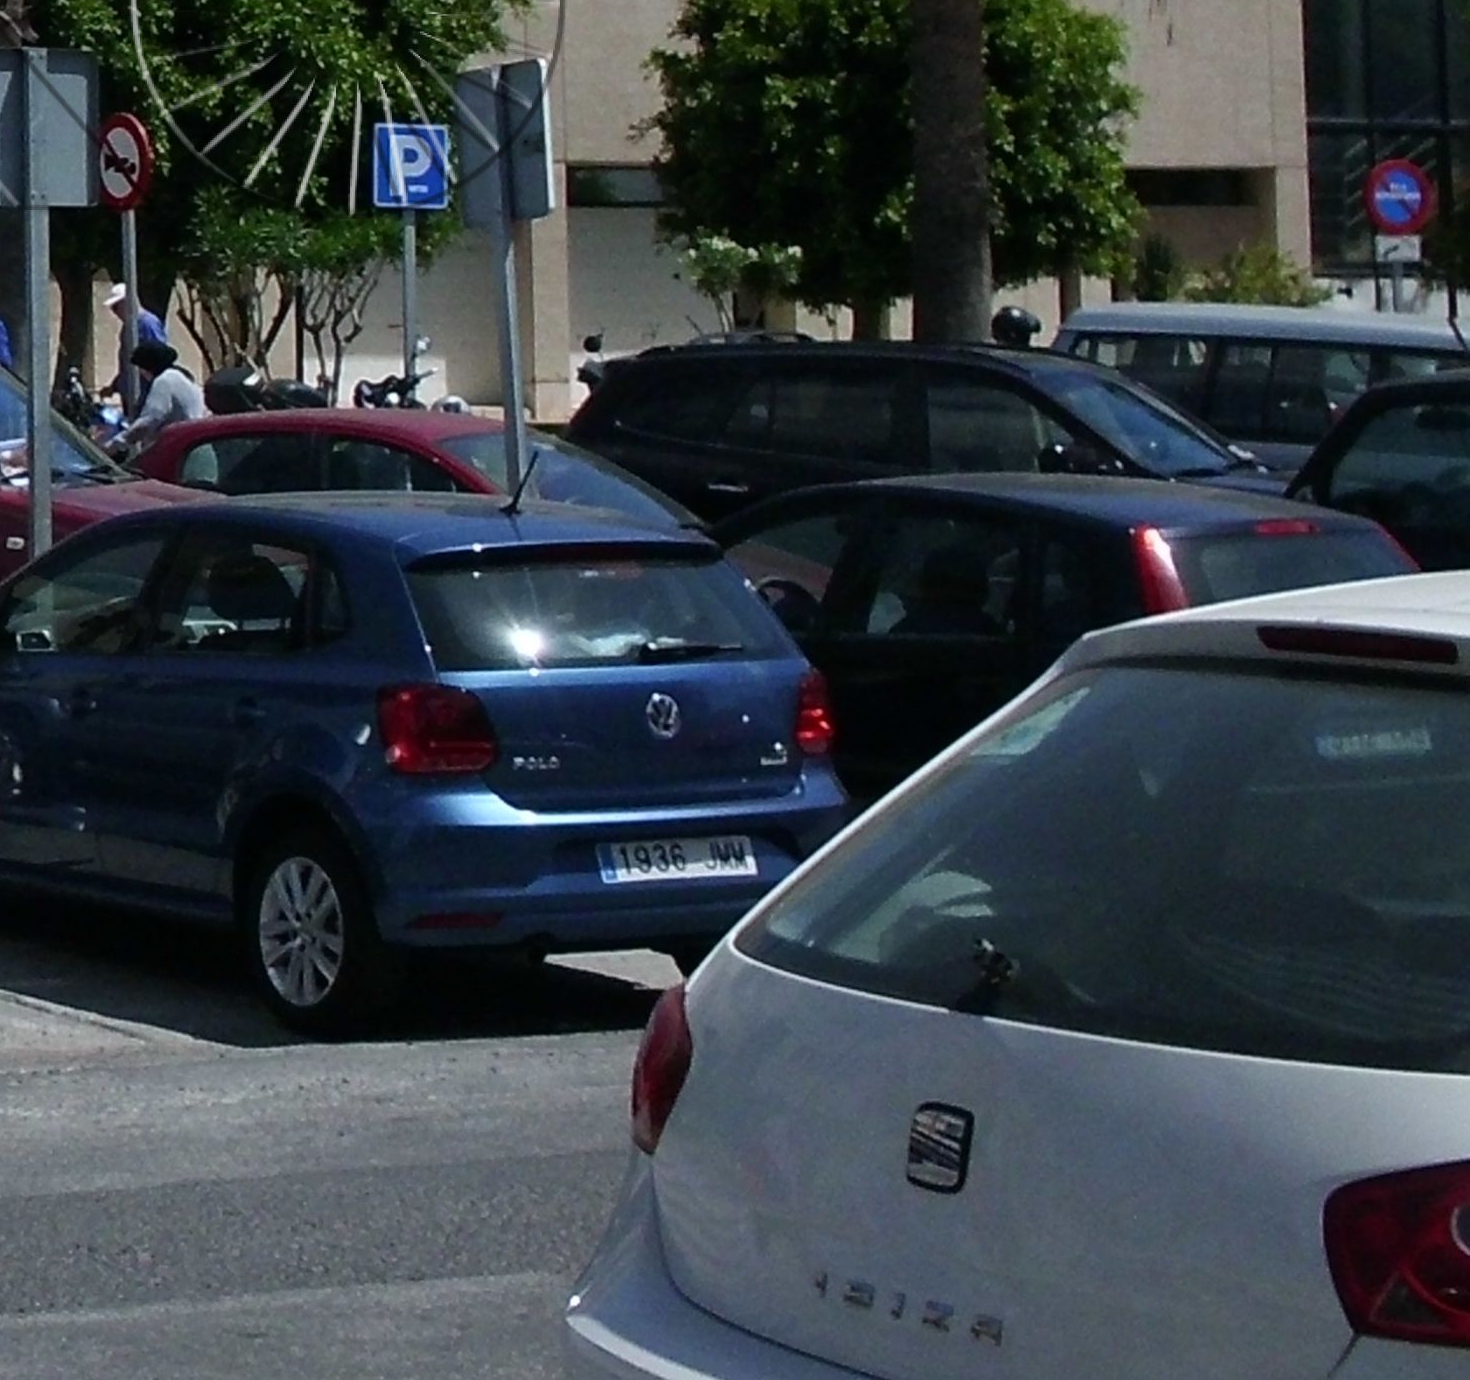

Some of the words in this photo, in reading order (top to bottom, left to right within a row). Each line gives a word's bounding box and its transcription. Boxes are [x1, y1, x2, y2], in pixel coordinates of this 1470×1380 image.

[389, 135, 431, 197] P
[513, 755, 559, 770] POLO
[619, 842, 686, 876] 1936
[705, 836, 748, 870] JMM
[815, 1272, 1003, 1346] IBIZA
